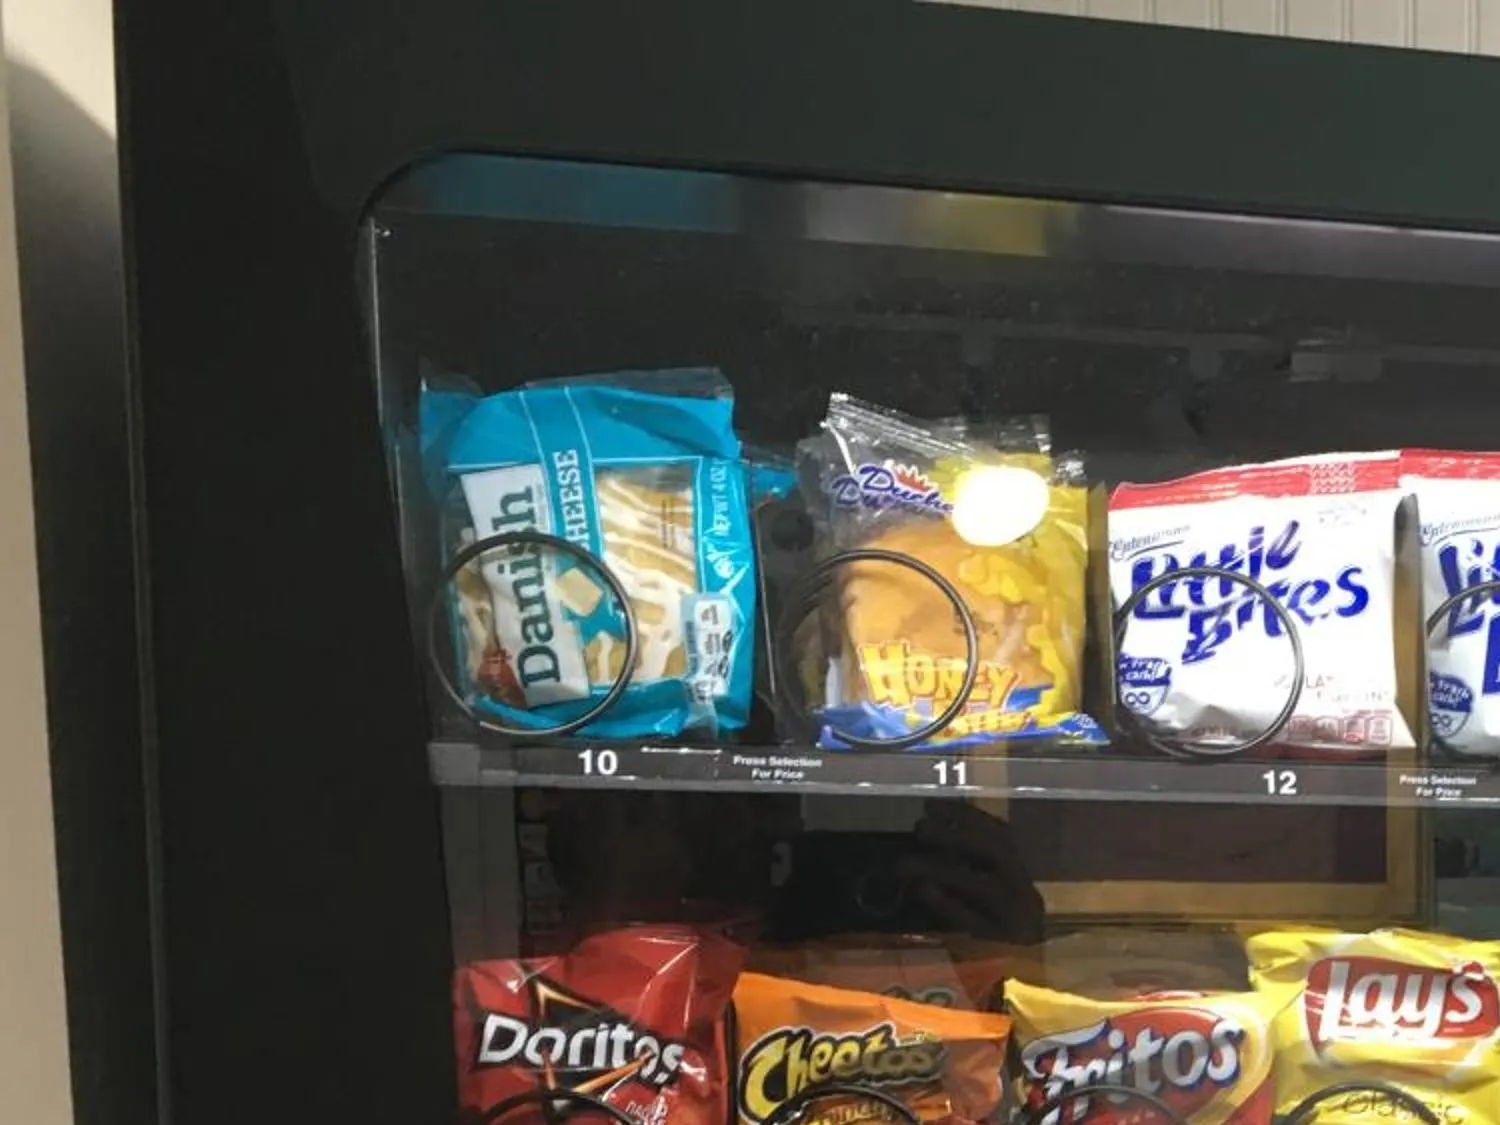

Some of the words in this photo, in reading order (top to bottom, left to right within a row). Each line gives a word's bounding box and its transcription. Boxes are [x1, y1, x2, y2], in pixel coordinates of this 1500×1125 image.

[551, 449, 591, 553] HEESE
[490, 486, 560, 689] Danish
[578, 749, 618, 775] 10
[732, 755, 766, 767] Press
[768, 756, 823, 768] Selection
[752, 768, 772, 780] For
[774, 768, 804, 780] Price
[933, 760, 967, 785] 11
[1263, 769, 1298, 795] 12
[477, 1013, 686, 1084] Doritos
[739, 1022, 945, 1124] Cheetos
[1343, 1089, 1466, 1125] Claic
